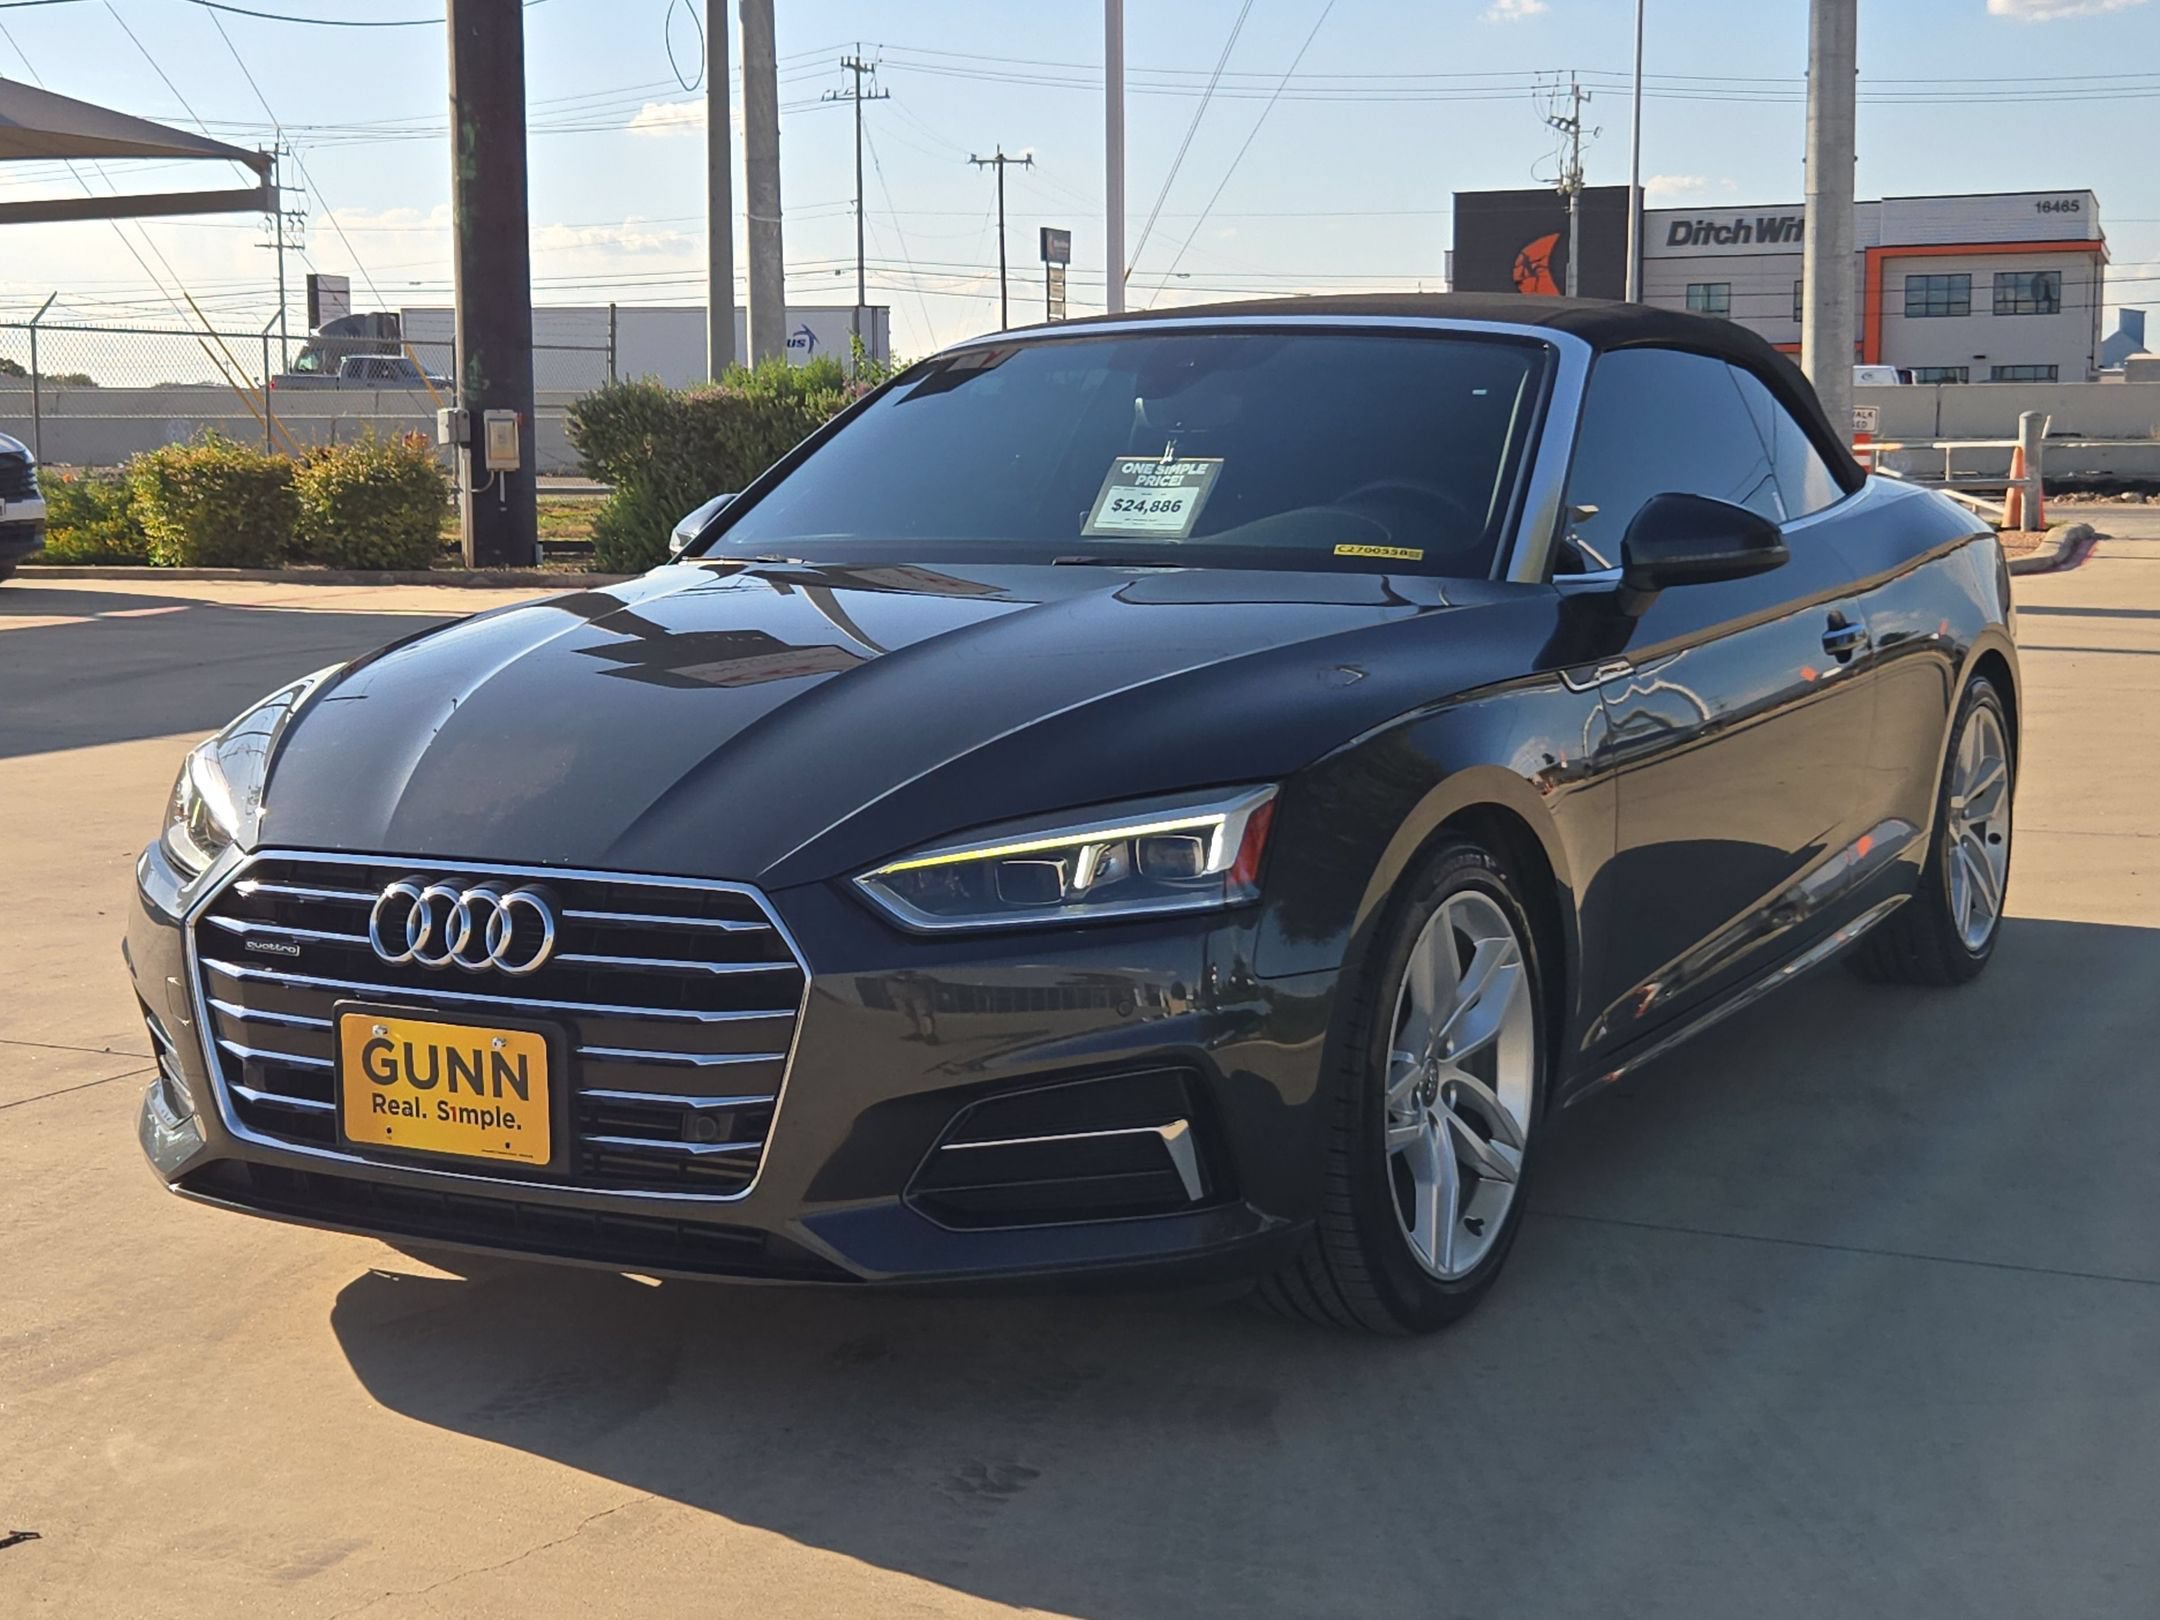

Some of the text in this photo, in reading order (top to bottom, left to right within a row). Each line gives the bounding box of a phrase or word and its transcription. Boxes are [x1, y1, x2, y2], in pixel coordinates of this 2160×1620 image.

[2035, 199, 2080, 214] 16465
[1665, 216, 1805, 247] Ditch Wit
[1121, 462, 1209, 474] ONE SIMPLE
[1134, 475, 1184, 486] PRICE!
[1111, 498, 1183, 515] $24,886
[246, 941, 296, 953] quattro
[361, 1037, 530, 1101] GUNN
[371, 1092, 428, 1120] Real.
